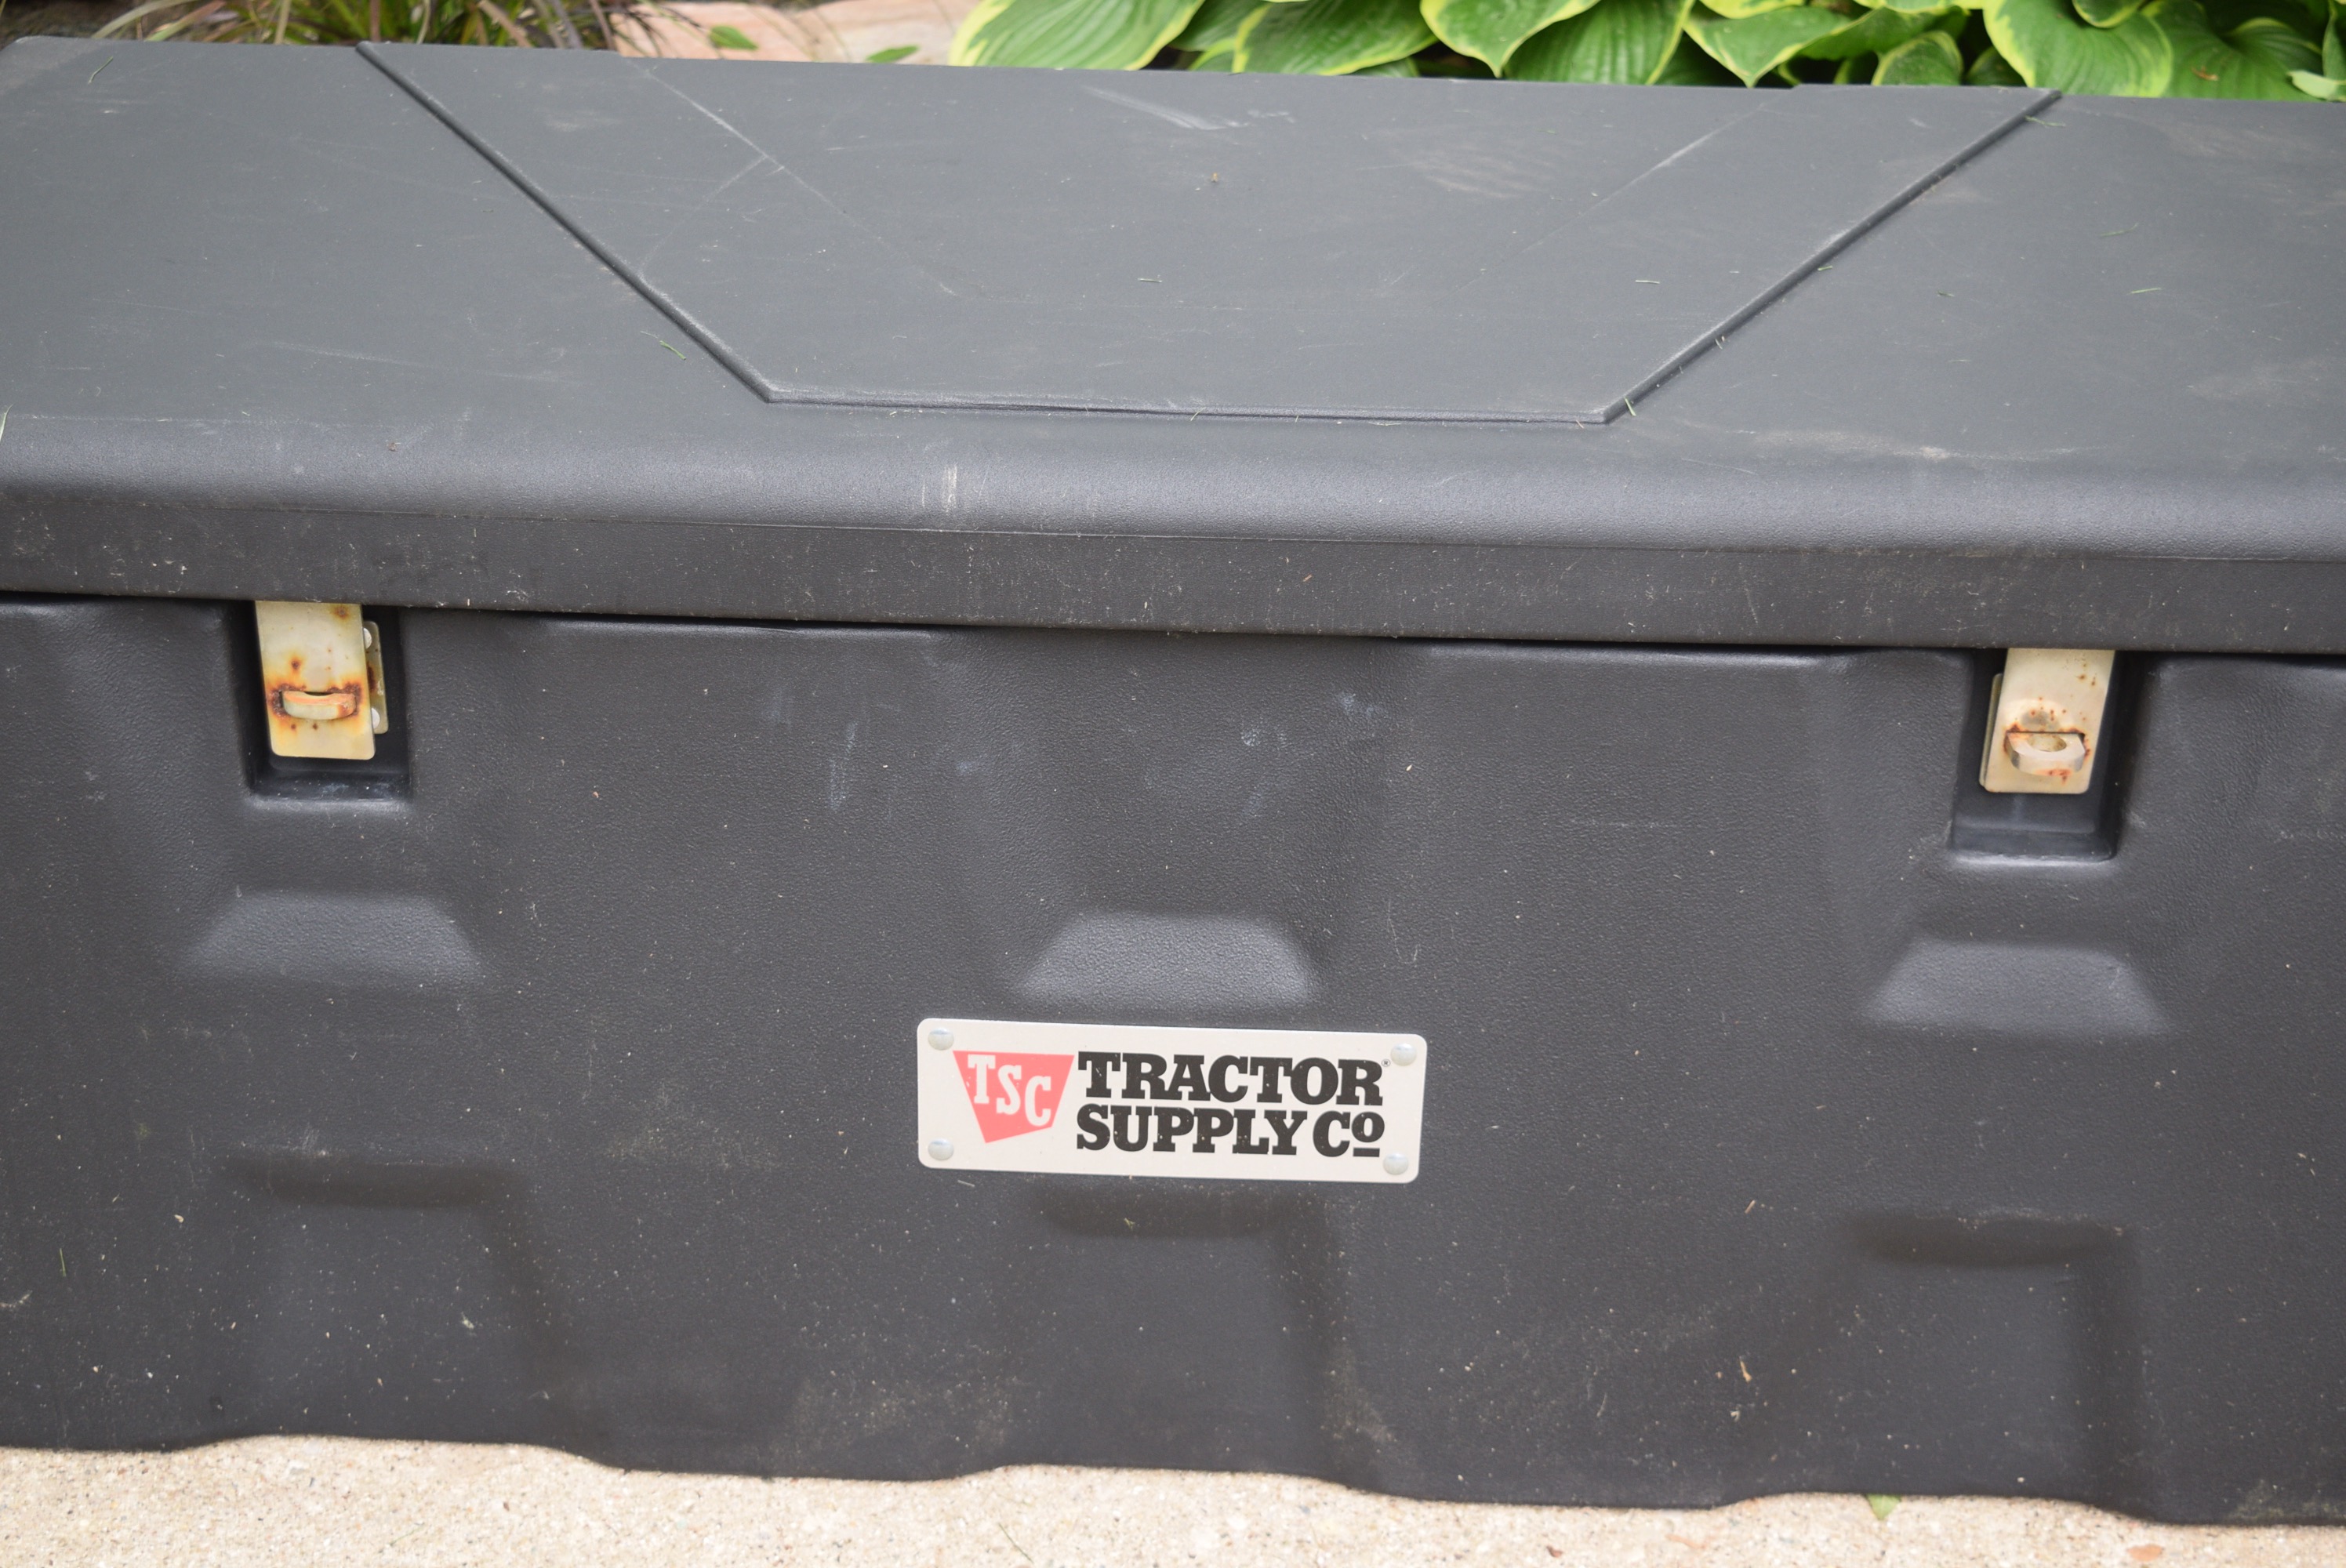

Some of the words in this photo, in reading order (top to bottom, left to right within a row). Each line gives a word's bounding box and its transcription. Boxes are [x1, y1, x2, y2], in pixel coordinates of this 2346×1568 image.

[968, 1054, 1051, 1127] TSC
[1077, 1051, 1383, 1106] TRACTOR
[1077, 1103, 1308, 1156] SUPPLY
